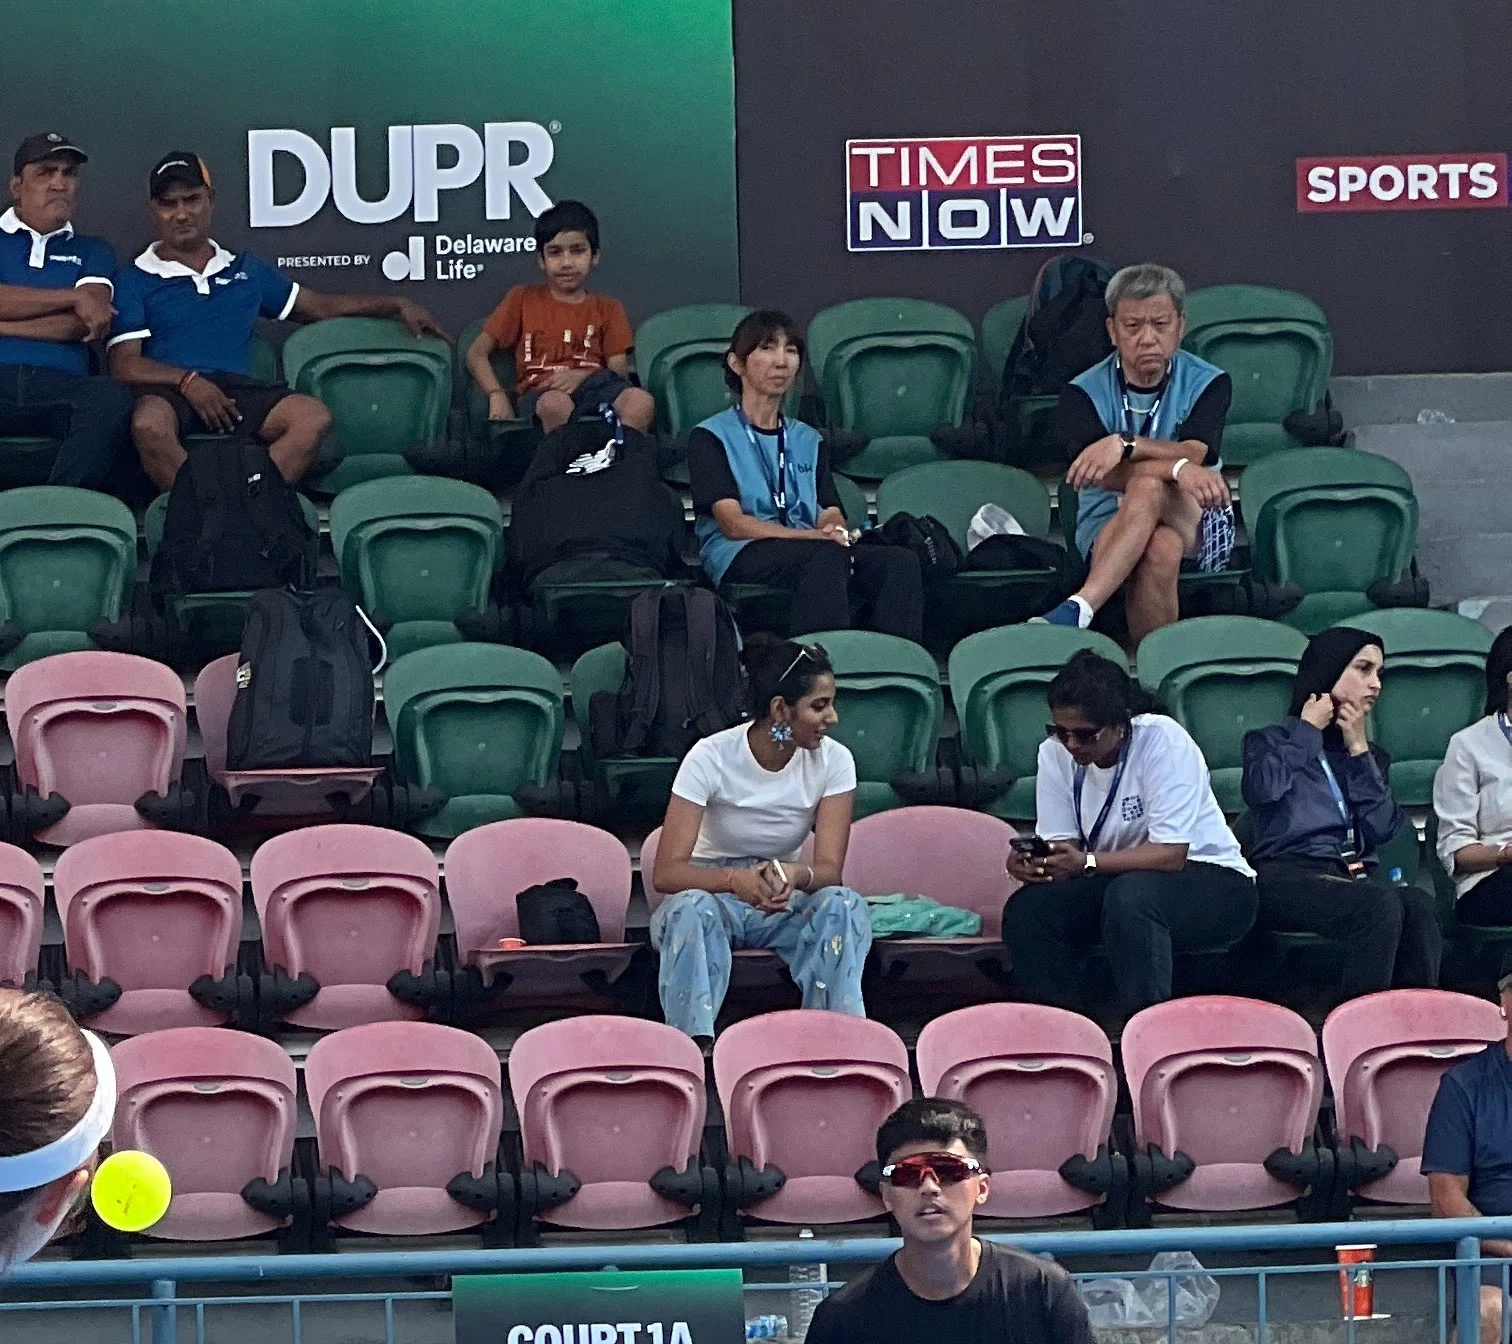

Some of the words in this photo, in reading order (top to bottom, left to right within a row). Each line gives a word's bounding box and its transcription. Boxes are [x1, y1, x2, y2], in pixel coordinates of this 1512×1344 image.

[248, 121, 555, 228] DUPR
[851, 143, 1076, 187] TIMES
[1307, 162, 1499, 203] SPORTS
[859, 197, 1076, 241] NOW
[277, 255, 351, 268] PRESENTED
[354, 254, 371, 265] BY
[435, 234, 537, 255] Delaware
[436, 259, 477, 280] Life
